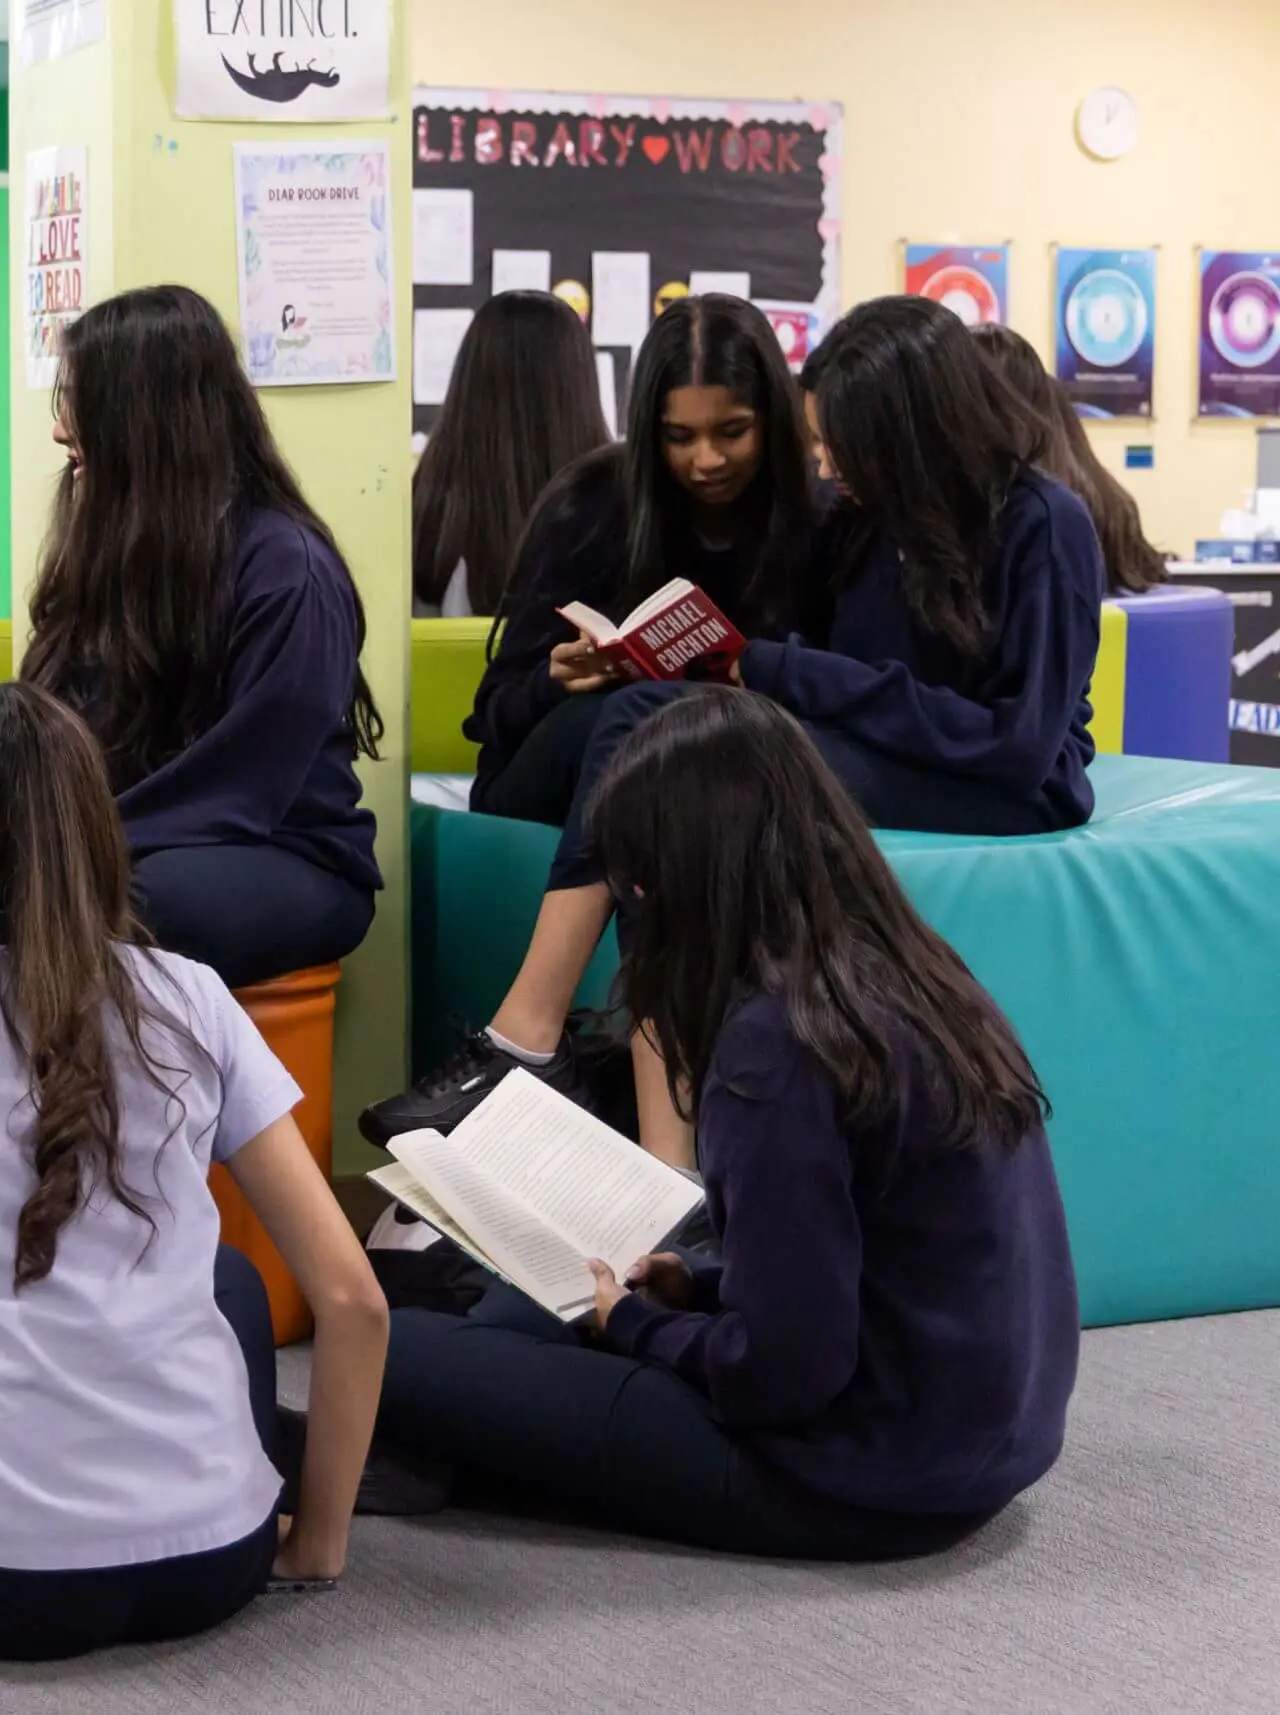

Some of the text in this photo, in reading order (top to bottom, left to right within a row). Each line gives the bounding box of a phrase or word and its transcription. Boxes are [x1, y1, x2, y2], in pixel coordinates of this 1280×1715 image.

[205, 0, 358, 38] EXTINCT.
[417, 114, 803, 173] LIBRARY WORK
[37, 217, 80, 261] LOVE
[45, 268, 82, 309] READ
[639, 599, 707, 650] MICHAEL
[656, 618, 729, 672] CRICHTON
